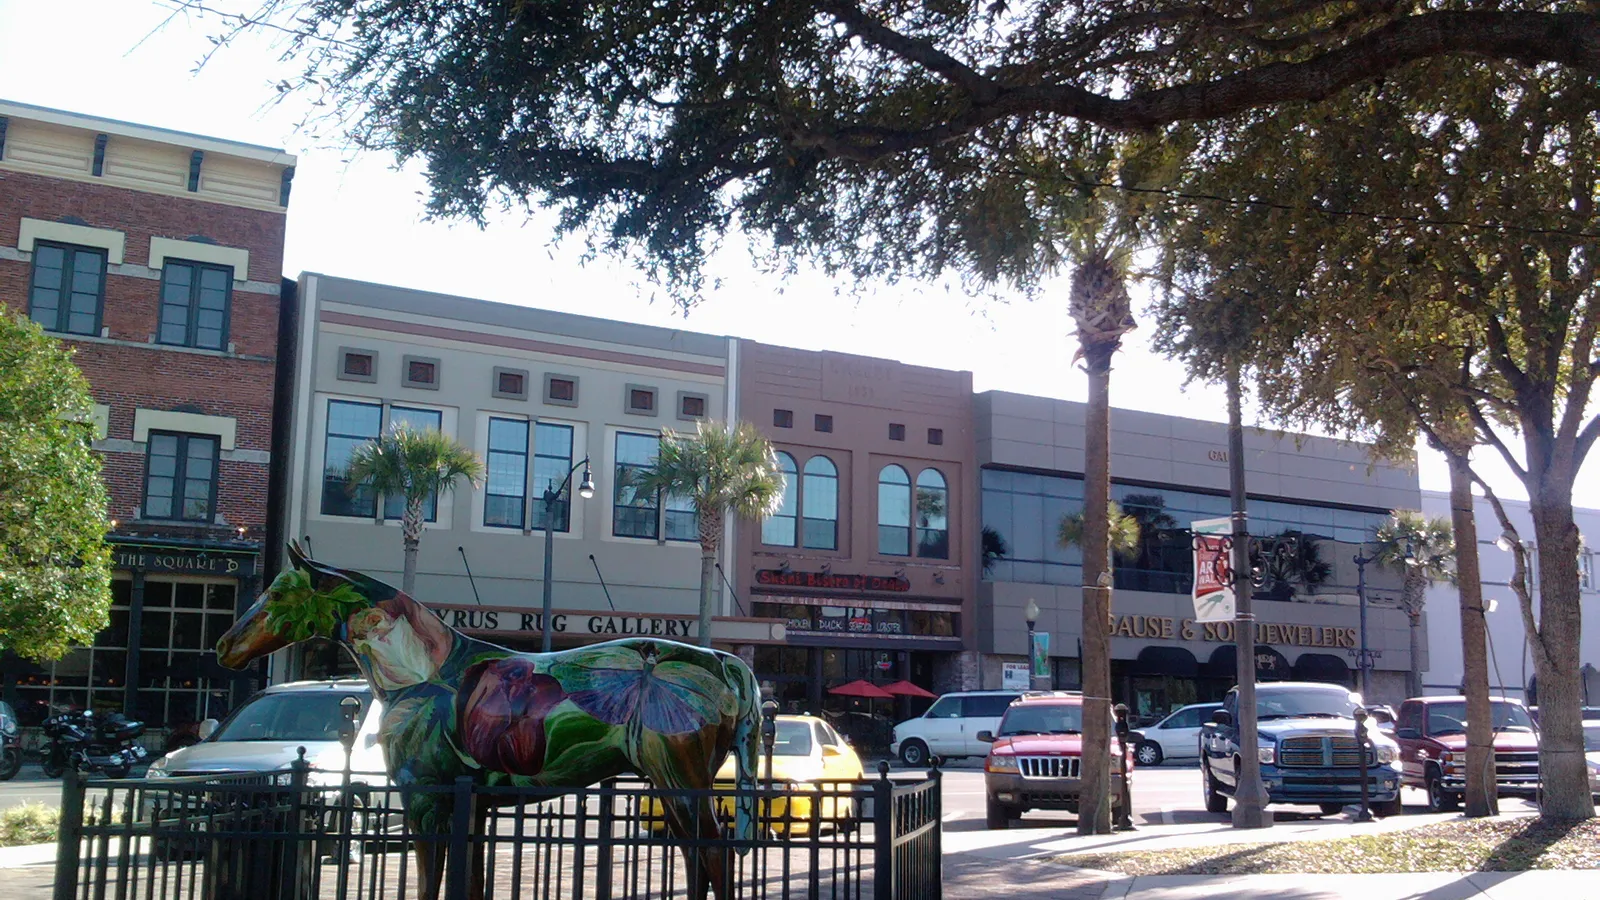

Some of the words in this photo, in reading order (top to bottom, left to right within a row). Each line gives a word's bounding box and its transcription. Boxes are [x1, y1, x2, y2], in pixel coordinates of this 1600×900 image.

[119, 553, 146, 566] THE
[153, 555, 216, 570] SQUARE
[434, 608, 499, 629] YRUS
[520, 613, 568, 632] RUG
[588, 616, 694, 637] GALLERY
[819, 619, 844, 630] DUCK
[876, 622, 903, 633] LOBSTER
[1181, 618, 1196, 640] &
[1254, 623, 1356, 648] JEWELERS
